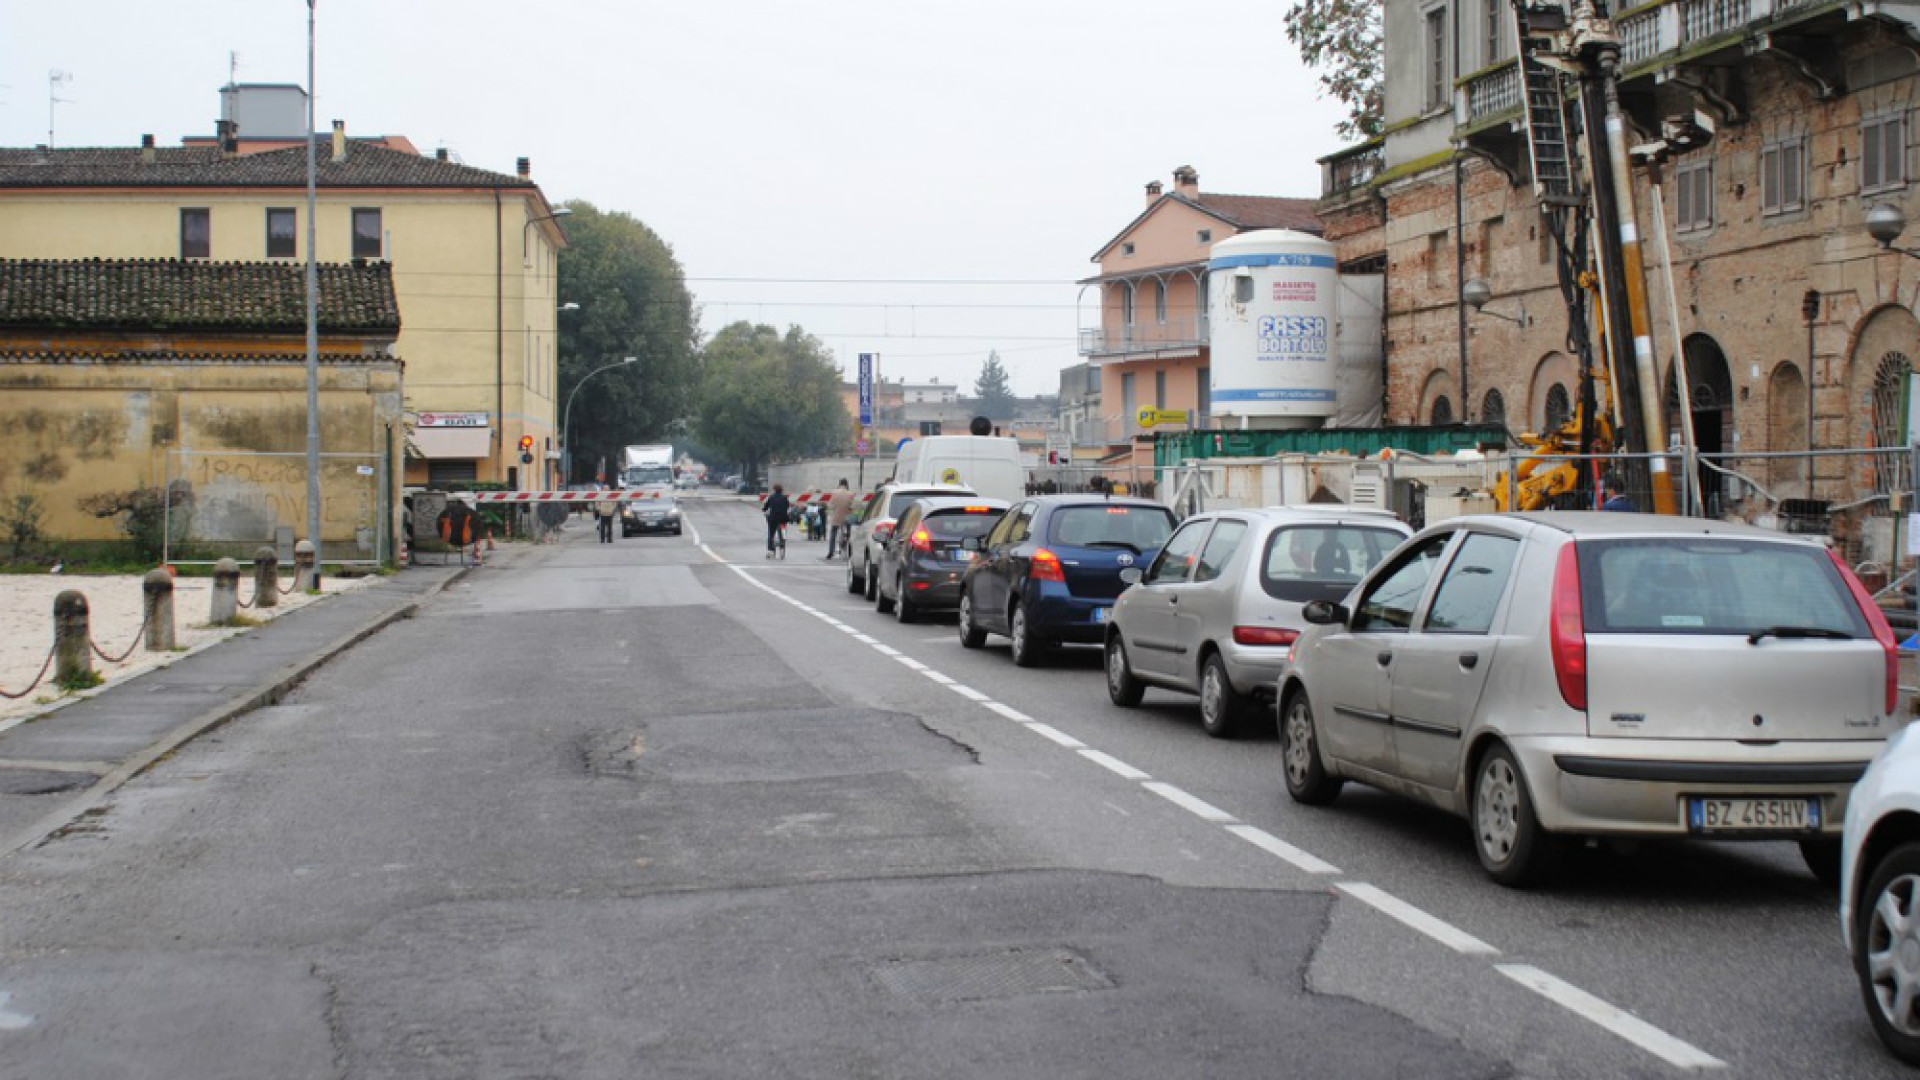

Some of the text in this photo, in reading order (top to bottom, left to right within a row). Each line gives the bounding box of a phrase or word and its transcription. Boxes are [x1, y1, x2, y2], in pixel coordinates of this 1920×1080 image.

[1258, 316, 1327, 338] FASSA
[1258, 338, 1327, 353] BORTOLO
[1706, 801, 1804, 826] BZ 465HV
